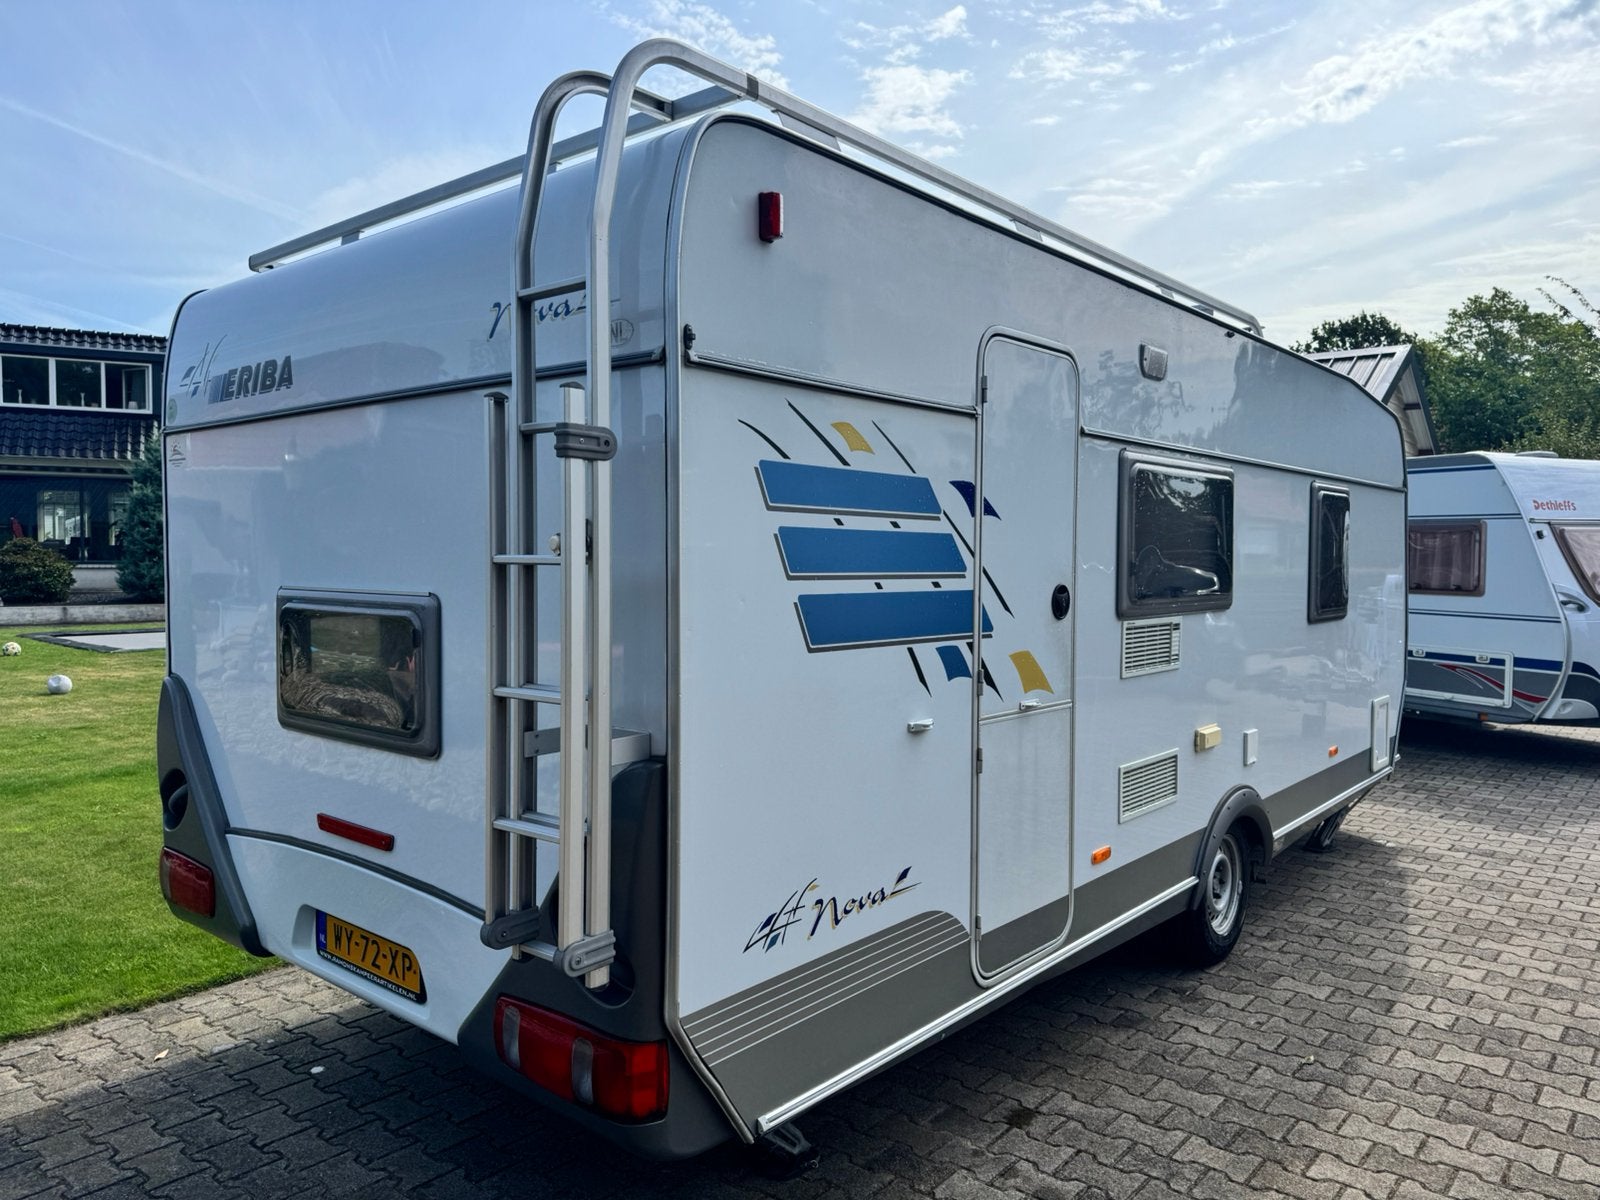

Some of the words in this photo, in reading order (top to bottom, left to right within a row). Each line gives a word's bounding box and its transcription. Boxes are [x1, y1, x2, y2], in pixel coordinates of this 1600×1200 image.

[223, 355, 294, 401] ERIBA
[1532, 499, 1577, 511] Dethleffs
[332, 922, 413, 982] WY-72-XP
